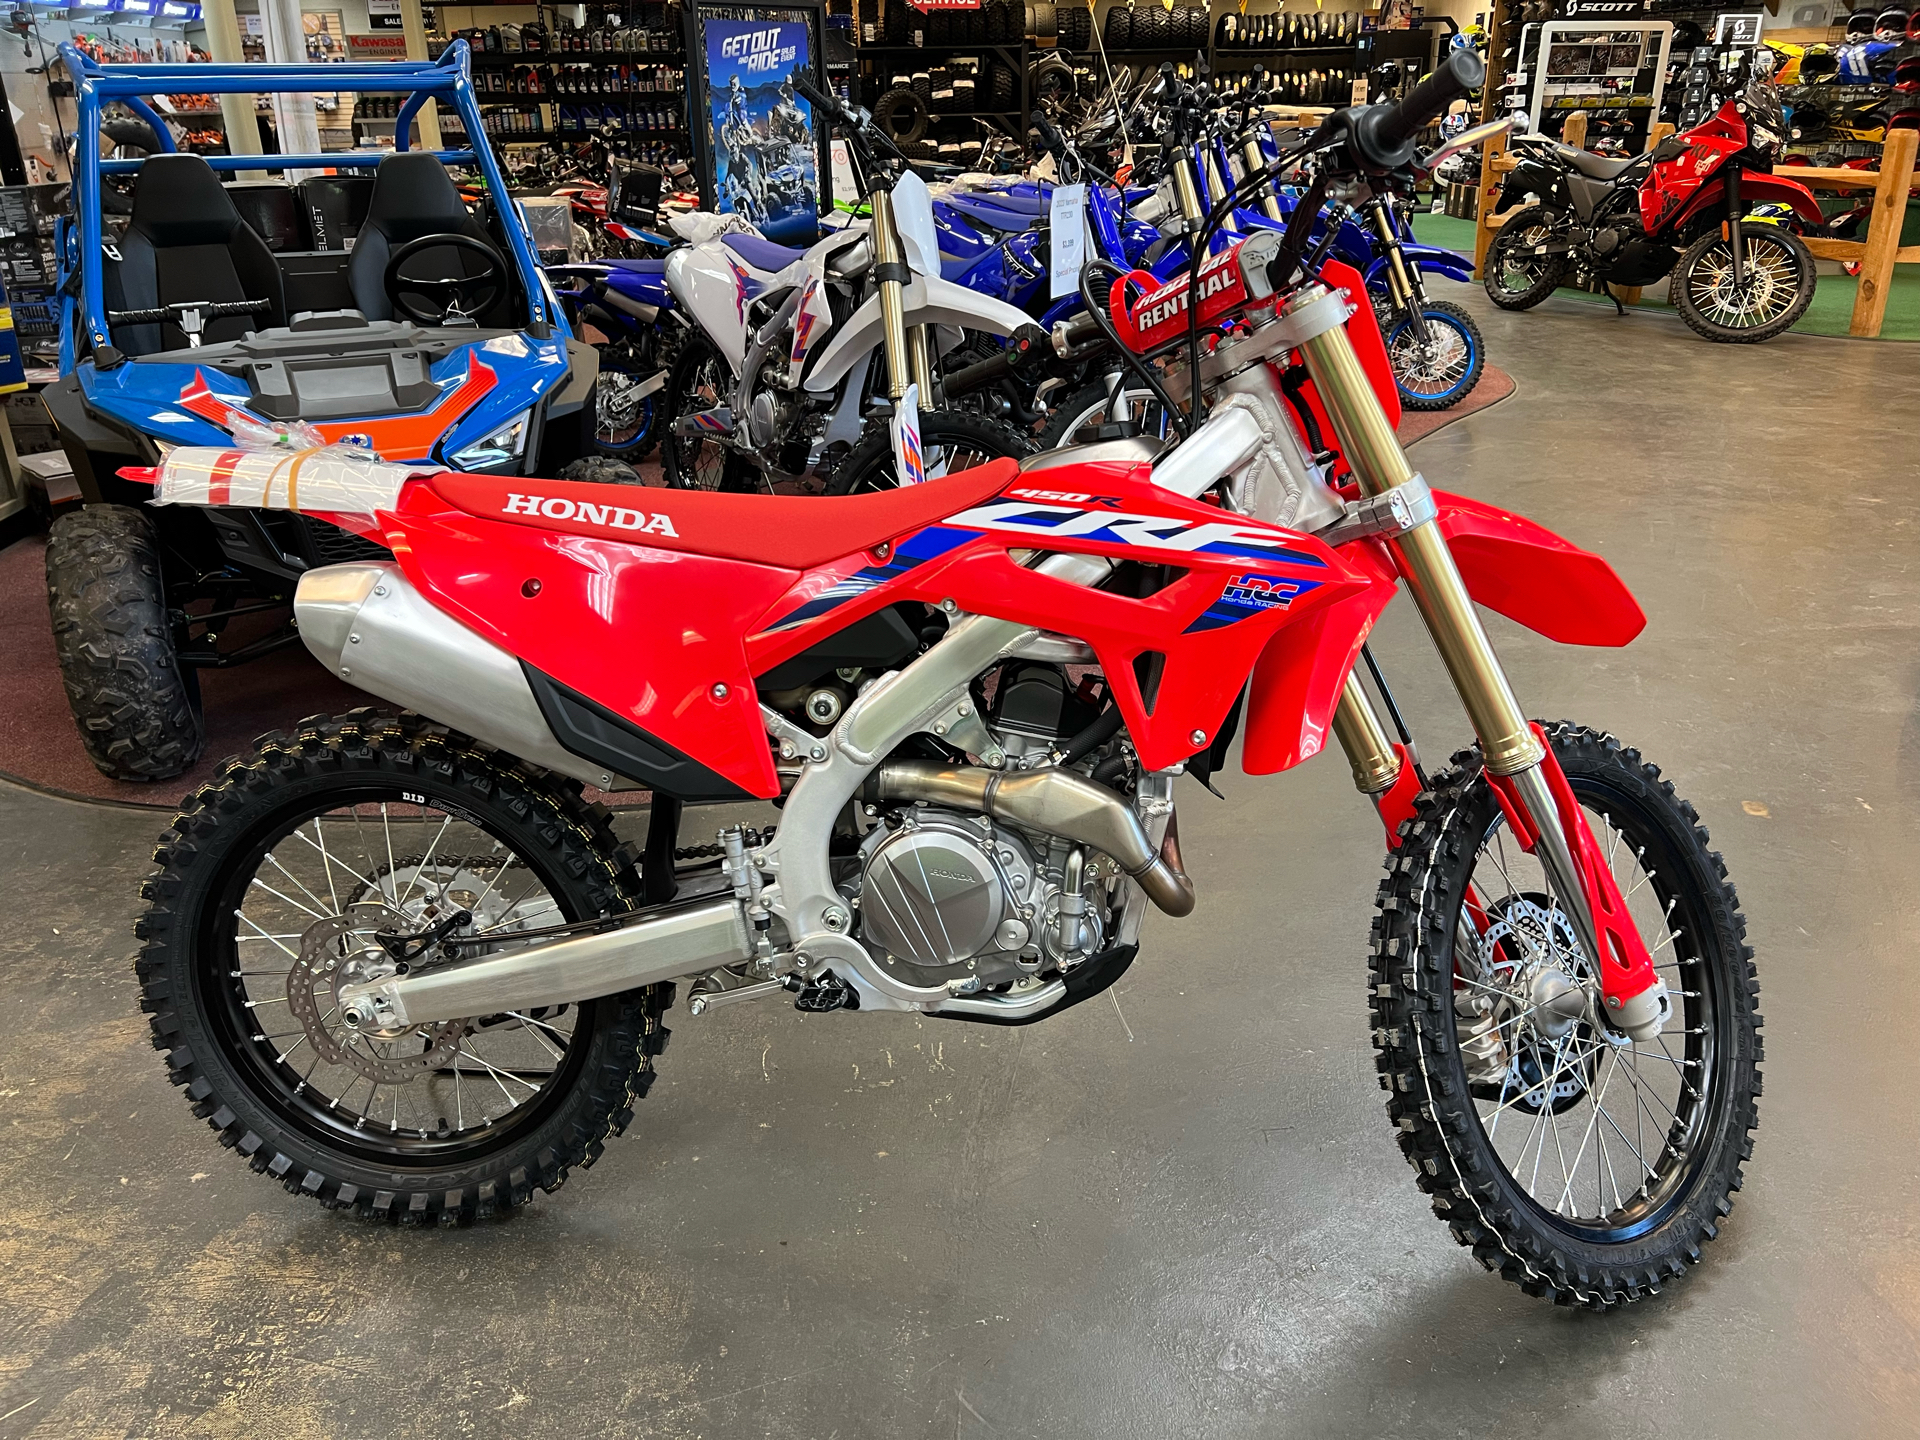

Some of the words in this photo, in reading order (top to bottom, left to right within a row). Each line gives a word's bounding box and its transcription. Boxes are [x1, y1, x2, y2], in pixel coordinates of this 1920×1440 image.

[1578, 2, 1637, 11] SCOTT
[350, 35, 405, 48] Kawasa
[722, 33, 751, 59] GET
[751, 27, 781, 53] OUT
[780, 45, 796, 56] SALES
[780, 52, 796, 63] EVENT
[738, 55, 749, 65] AND
[748, 48, 781, 75] RIDE
[312, 205, 328, 251] ELMET
[1138, 268, 1236, 332] RENTHAL
[502, 493, 680, 539] HONDA
[1222, 574, 1300, 606] HRC
[1254, 601, 1290, 612] RACING
[402, 791, 425, 803] DID
[930, 868, 976, 883] HONDA
